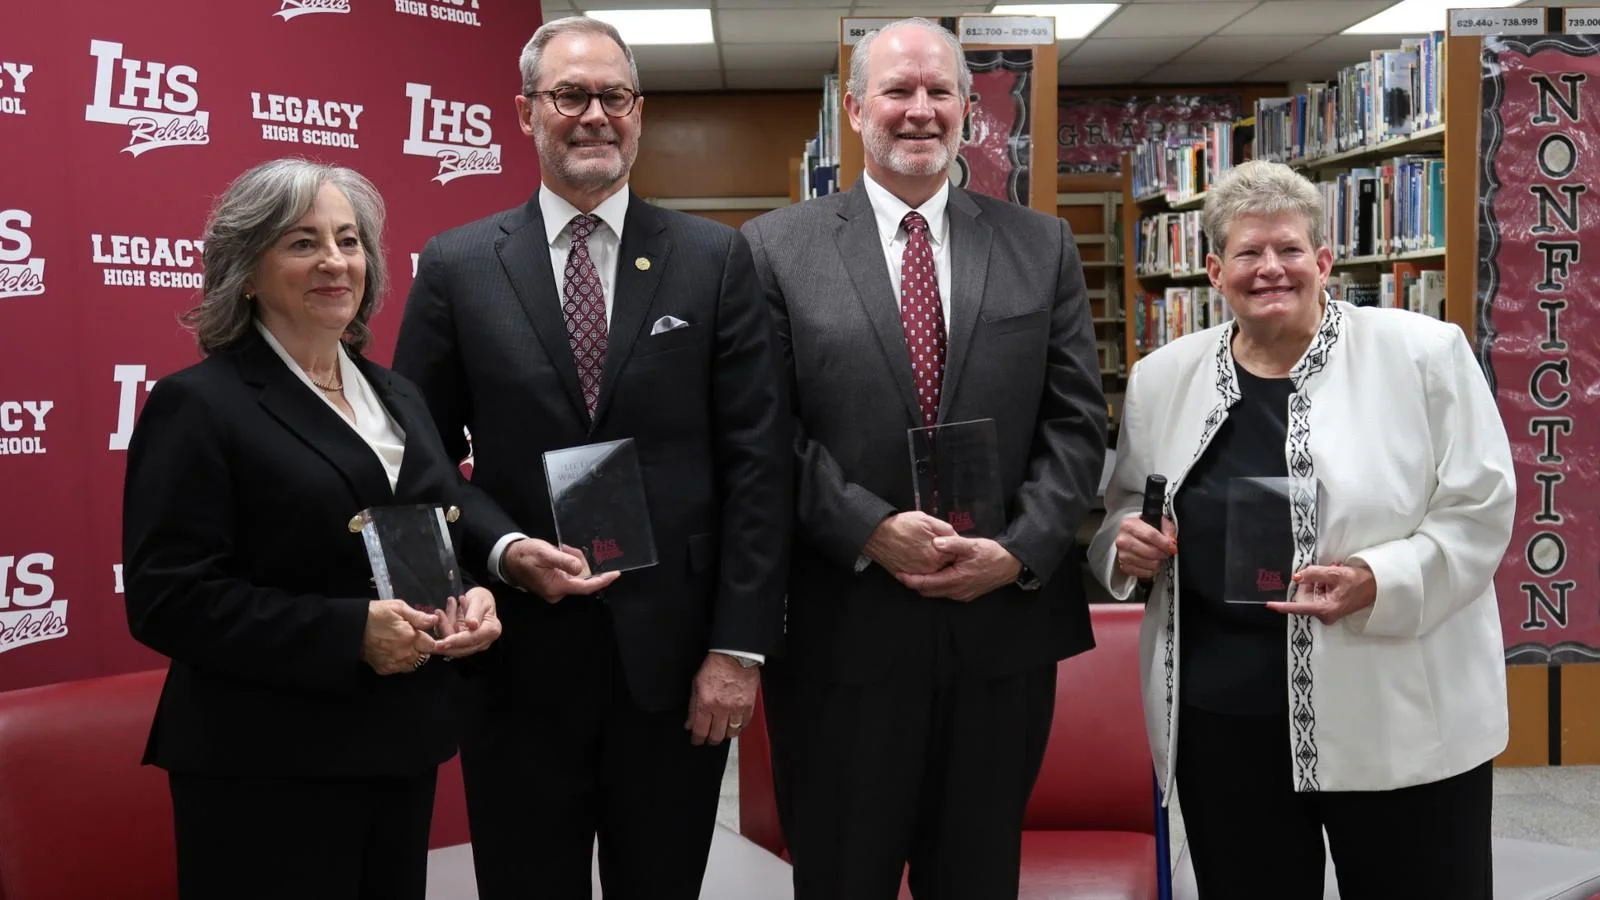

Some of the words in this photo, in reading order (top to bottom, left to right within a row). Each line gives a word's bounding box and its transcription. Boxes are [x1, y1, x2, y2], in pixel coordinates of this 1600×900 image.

[430, 5, 481, 27] SCHOOL
[1502, 18, 1538, 26] 738.999
[85, 39, 210, 127] LHS
[251, 92, 364, 130] LEGACY
[403, 82, 502, 158] LHS
[127, 116, 210, 148] Rebels
[262, 124, 300, 143] HIGH
[302, 129, 360, 149] SCHOOL
[435, 149, 502, 176] Rebels
[103, 268, 146, 286] HIGH
[150, 272, 203, 289] SCHOO
[1520, 73, 1587, 629] NONFICTION
